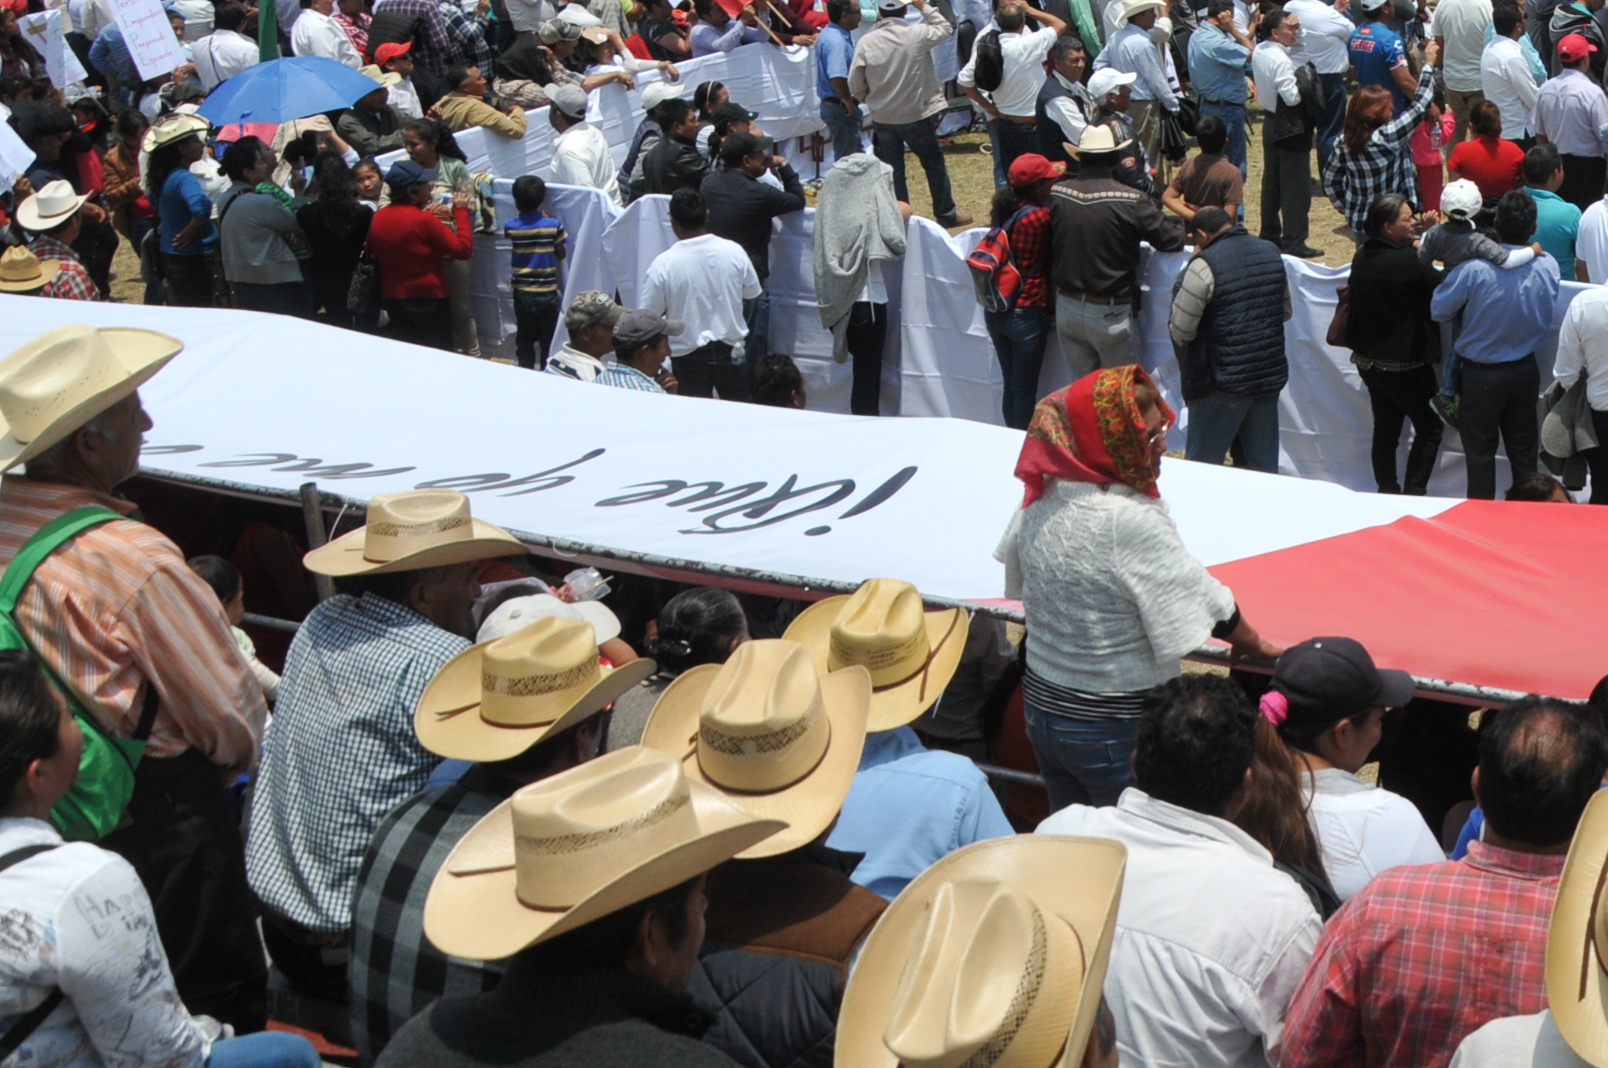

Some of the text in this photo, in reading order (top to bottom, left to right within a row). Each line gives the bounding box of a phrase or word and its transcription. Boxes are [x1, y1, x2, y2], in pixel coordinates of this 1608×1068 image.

[196, 447, 918, 537] ¡Que yo me
